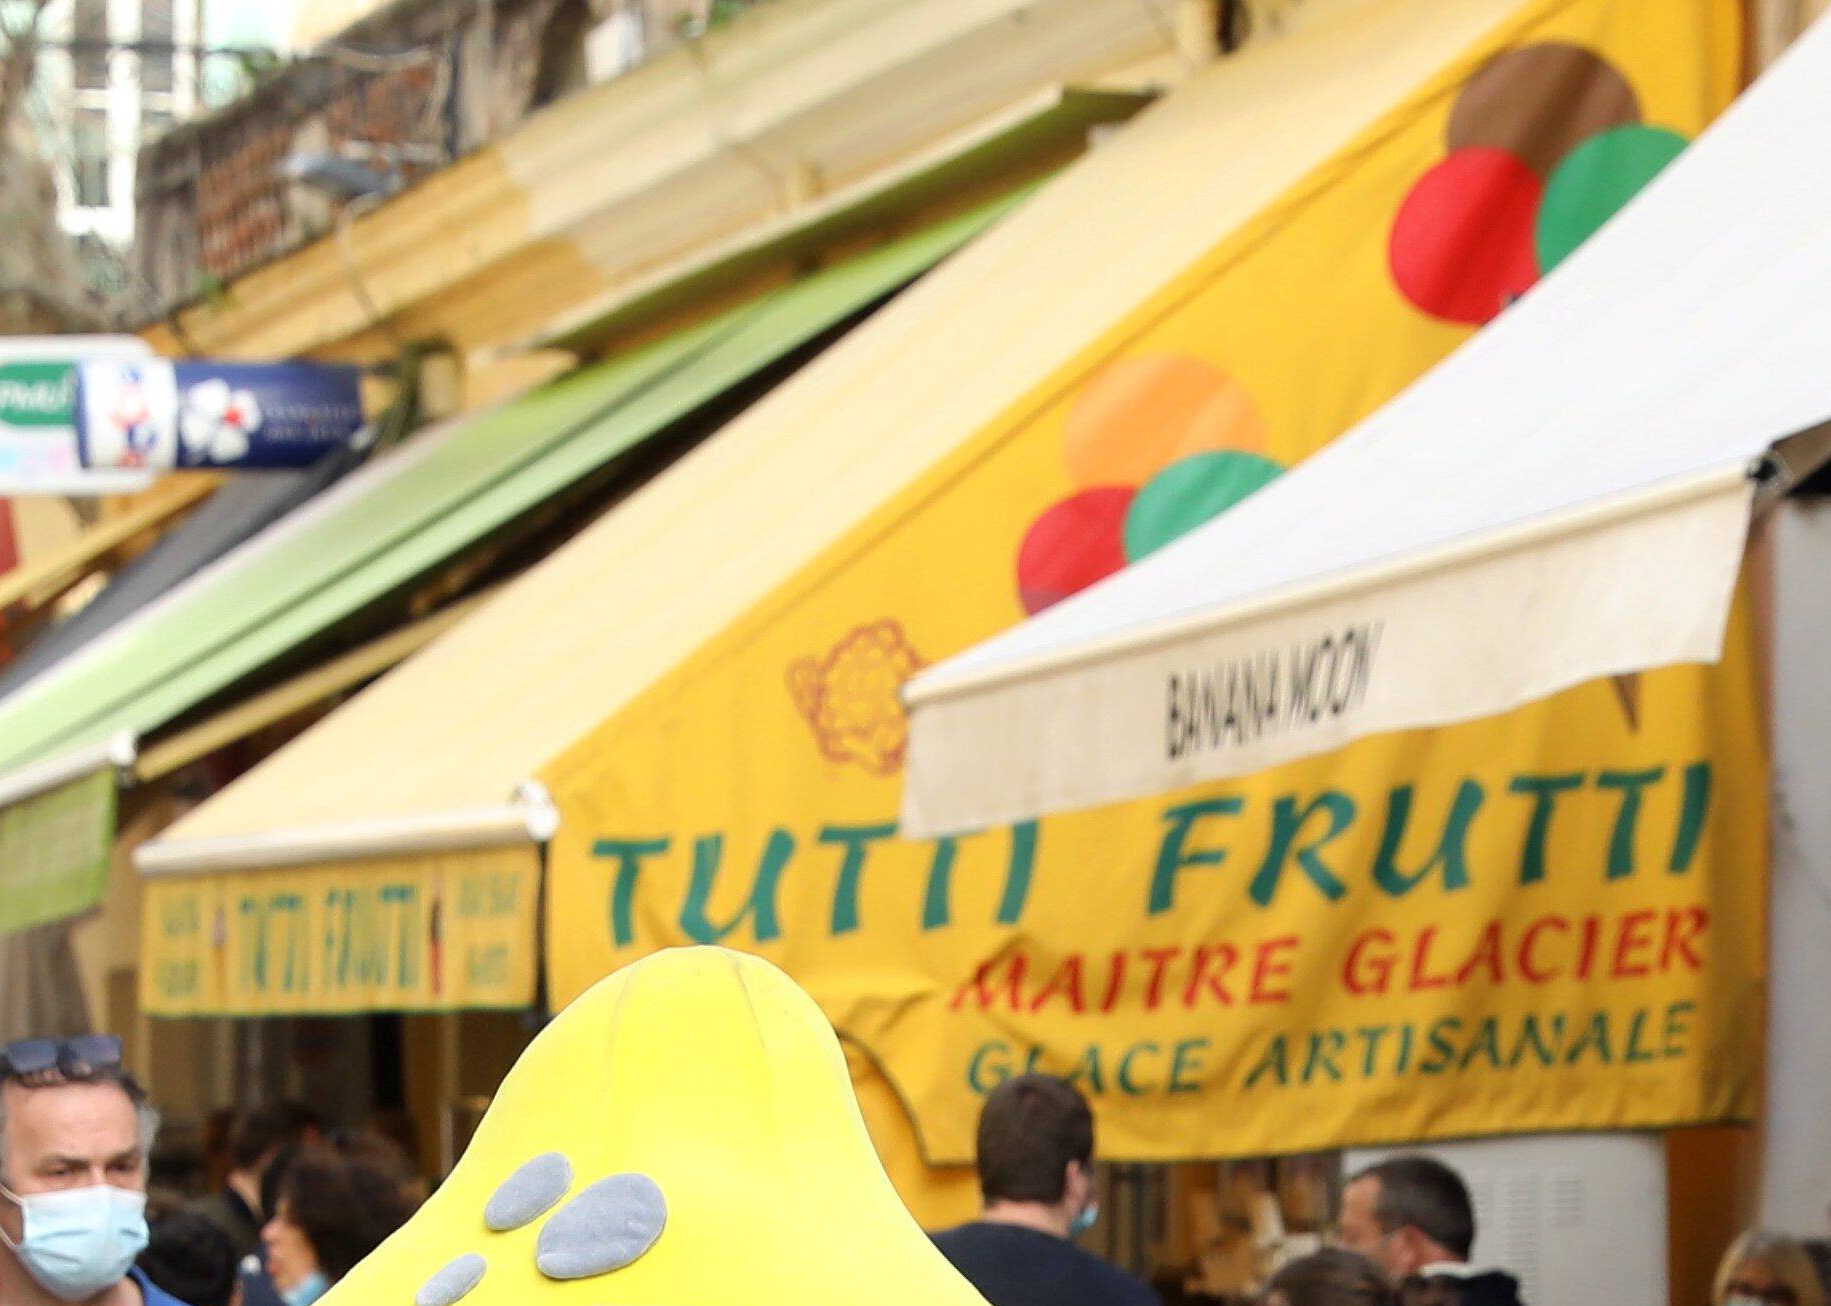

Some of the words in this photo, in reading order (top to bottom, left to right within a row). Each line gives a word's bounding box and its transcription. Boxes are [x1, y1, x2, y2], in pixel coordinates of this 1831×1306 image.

[1163, 645, 1287, 764] BANANA
[592, 818, 1039, 950] TUTTI
[1145, 760, 1714, 919] FRUTTI
[947, 932, 1302, 1015] MAITRE
[1340, 904, 1711, 1000] GLACIER
[1241, 1000, 1697, 1095] ARTISANALE
